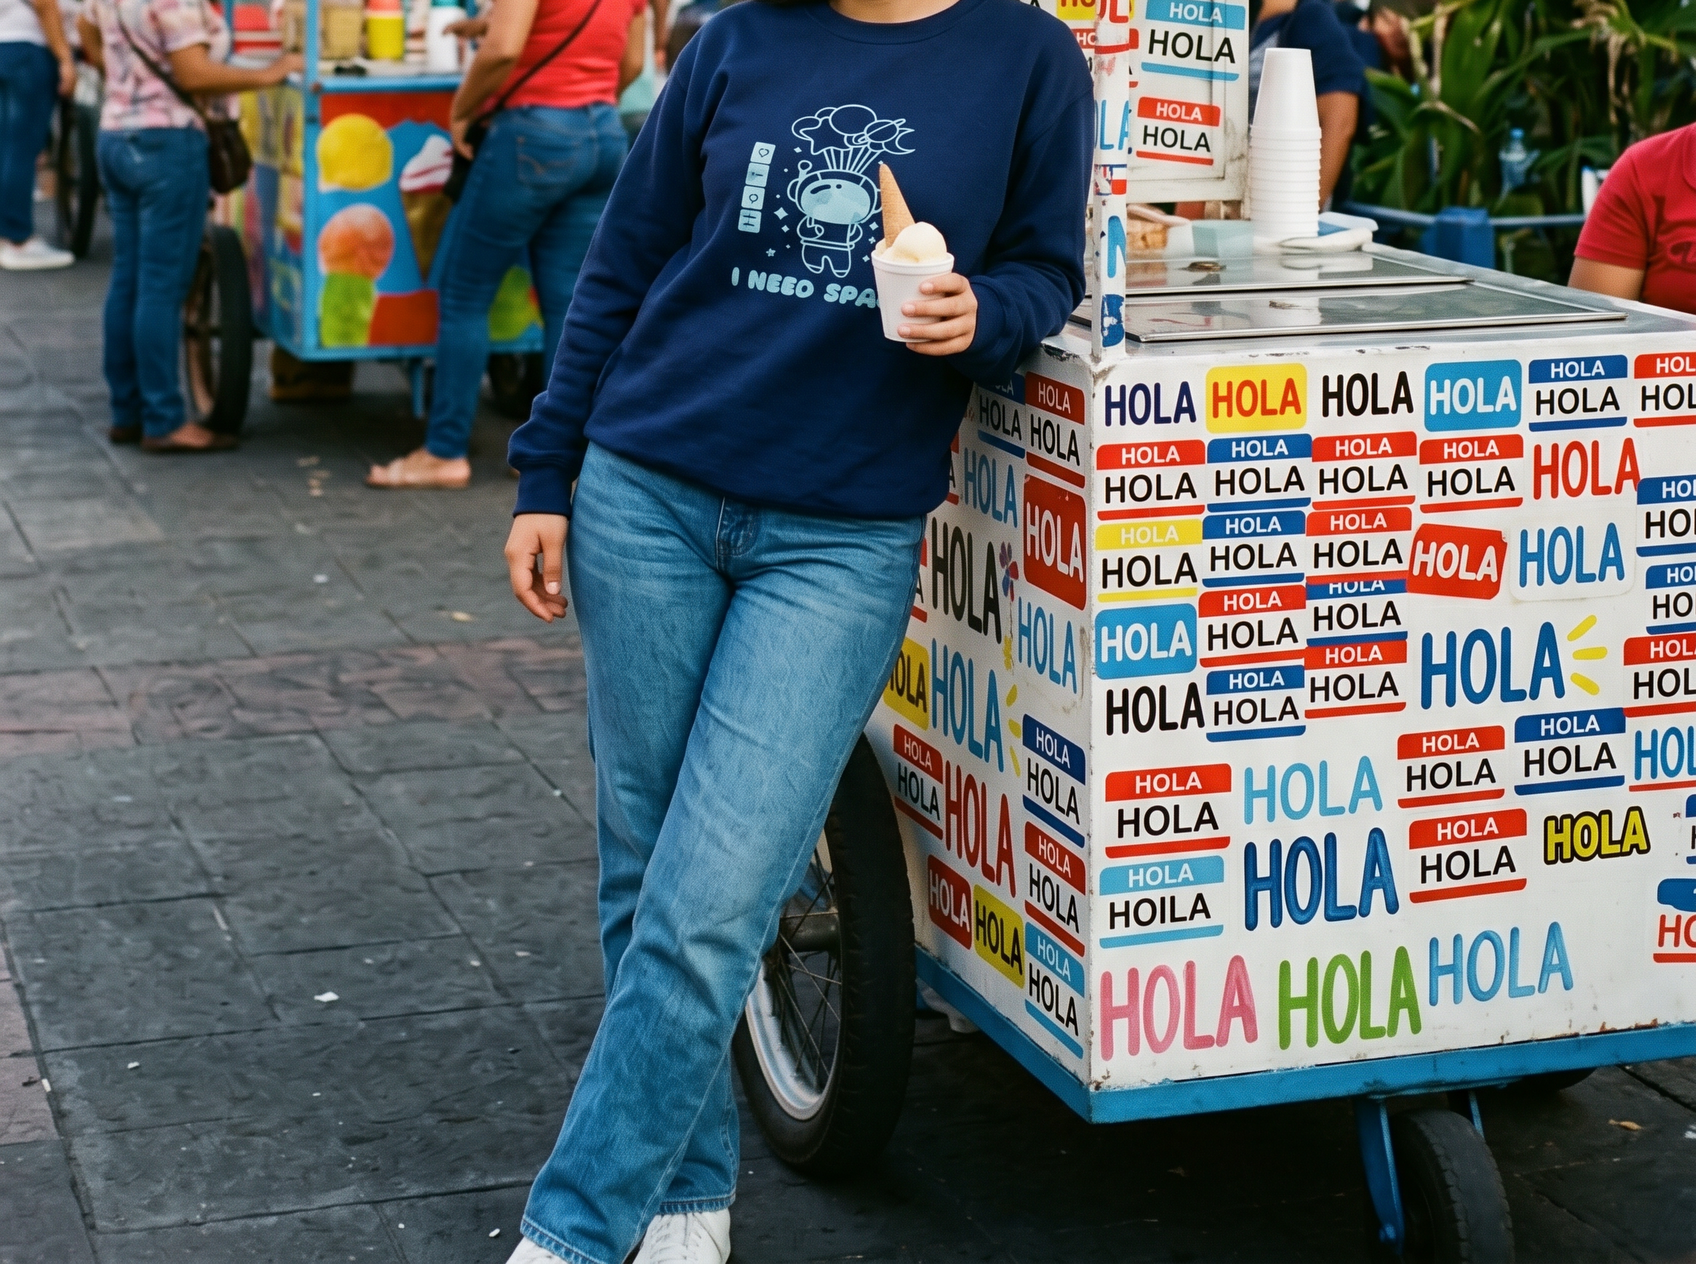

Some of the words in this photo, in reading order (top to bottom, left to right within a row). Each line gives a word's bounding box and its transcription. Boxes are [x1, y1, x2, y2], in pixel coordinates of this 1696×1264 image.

[1169, 3, 1222, 23] HOLA
[1148, 29, 1236, 63] HOLA
[1156, 103, 1202, 121] HOLA
[1142, 125, 1211, 152] HOLA
[731, 267, 740, 286] I
[748, 270, 814, 298] NEED
[824, 283, 882, 308] SPA
[1551, 360, 1605, 379] HOLA
[1656, 356, 1696, 374] HOL
[1038, 382, 1071, 414] HOLA
[1105, 381, 1196, 426] HOLA
[1212, 378, 1302, 418] HOLA
[1322, 371, 1414, 417] HOLA
[1430, 376, 1517, 415] HOLA
[1536, 386, 1620, 416] HOLA
[1641, 383, 1696, 412] HOL
[979, 394, 1022, 441] HOLA
[1031, 413, 1080, 466] HOLA
[1122, 446, 1180, 465] HOLA
[1232, 439, 1288, 458] HOLA
[1335, 437, 1392, 457] HOLA
[1443, 439, 1499, 460] HOLA
[1215, 466, 1305, 496] HOLA
[1319, 464, 1408, 495] HOLA
[1428, 466, 1515, 497] HOLA
[1533, 438, 1641, 500] HOLA
[964, 447, 1017, 528] HOLA
[1105, 472, 1197, 504] HOLA
[1120, 525, 1180, 544] HOLA
[1225, 516, 1282, 534] HOLA
[1330, 512, 1387, 531] HOLA
[1645, 509, 1696, 539] HO
[1027, 502, 1083, 583] HOLA
[1210, 542, 1297, 572] HOLA
[1313, 538, 1403, 569] HOLA
[1519, 522, 1625, 588] HOLA
[1102, 552, 1198, 588] HOLA
[1412, 540, 1498, 583] HOLA
[932, 517, 1002, 644] HOLA
[1328, 580, 1385, 594] HOLA
[1224, 590, 1282, 611] HOLA
[1313, 600, 1401, 632] HOLA
[1652, 592, 1696, 620] HO
[1019, 596, 1077, 694] HOLA
[1102, 620, 1192, 663] HOLA
[1208, 617, 1298, 651] HOLA
[1650, 639, 1696, 659] HOL
[1325, 645, 1383, 664] HOLA
[1421, 621, 1565, 710] HOLA
[1229, 670, 1284, 690] HOLA
[1310, 671, 1399, 703] HOLA
[1633, 667, 1696, 699] HOL
[932, 638, 1004, 773] HOLA
[1106, 682, 1205, 736] HOLA
[1214, 696, 1300, 726] HOLA
[1422, 732, 1480, 753] HOLA
[1541, 715, 1600, 736] HOLA
[904, 736, 932, 771] HOLA
[1036, 727, 1070, 768] HOLA
[1524, 742, 1617, 777] HOLA
[1634, 726, 1696, 781] HOL
[898, 762, 940, 821] HOLA
[1027, 757, 1080, 825] HOLA
[1135, 772, 1202, 794] HOLA
[1244, 755, 1383, 825] HOLA
[1406, 758, 1496, 792] HOLA
[945, 760, 1016, 898] HOLA
[1118, 802, 1219, 838] HOLA
[1437, 817, 1499, 841] HOLA
[1543, 806, 1651, 865] HOLA
[1038, 835, 1071, 878] HOLA
[1421, 845, 1516, 884] HOLA
[1128, 863, 1194, 888] HOLA
[1244, 827, 1399, 931] HOLA
[929, 869, 970, 934] HOLA
[1029, 862, 1080, 934] HOLA
[1110, 893, 1211, 930] HOILA
[976, 900, 1023, 976] HOLA
[1037, 935, 1071, 982] HOLA
[1429, 921, 1574, 1006] HOLA
[1029, 963, 1079, 1036] HOLA
[1101, 955, 1258, 1061] HOLA
[1278, 945, 1422, 1050] HOLA
